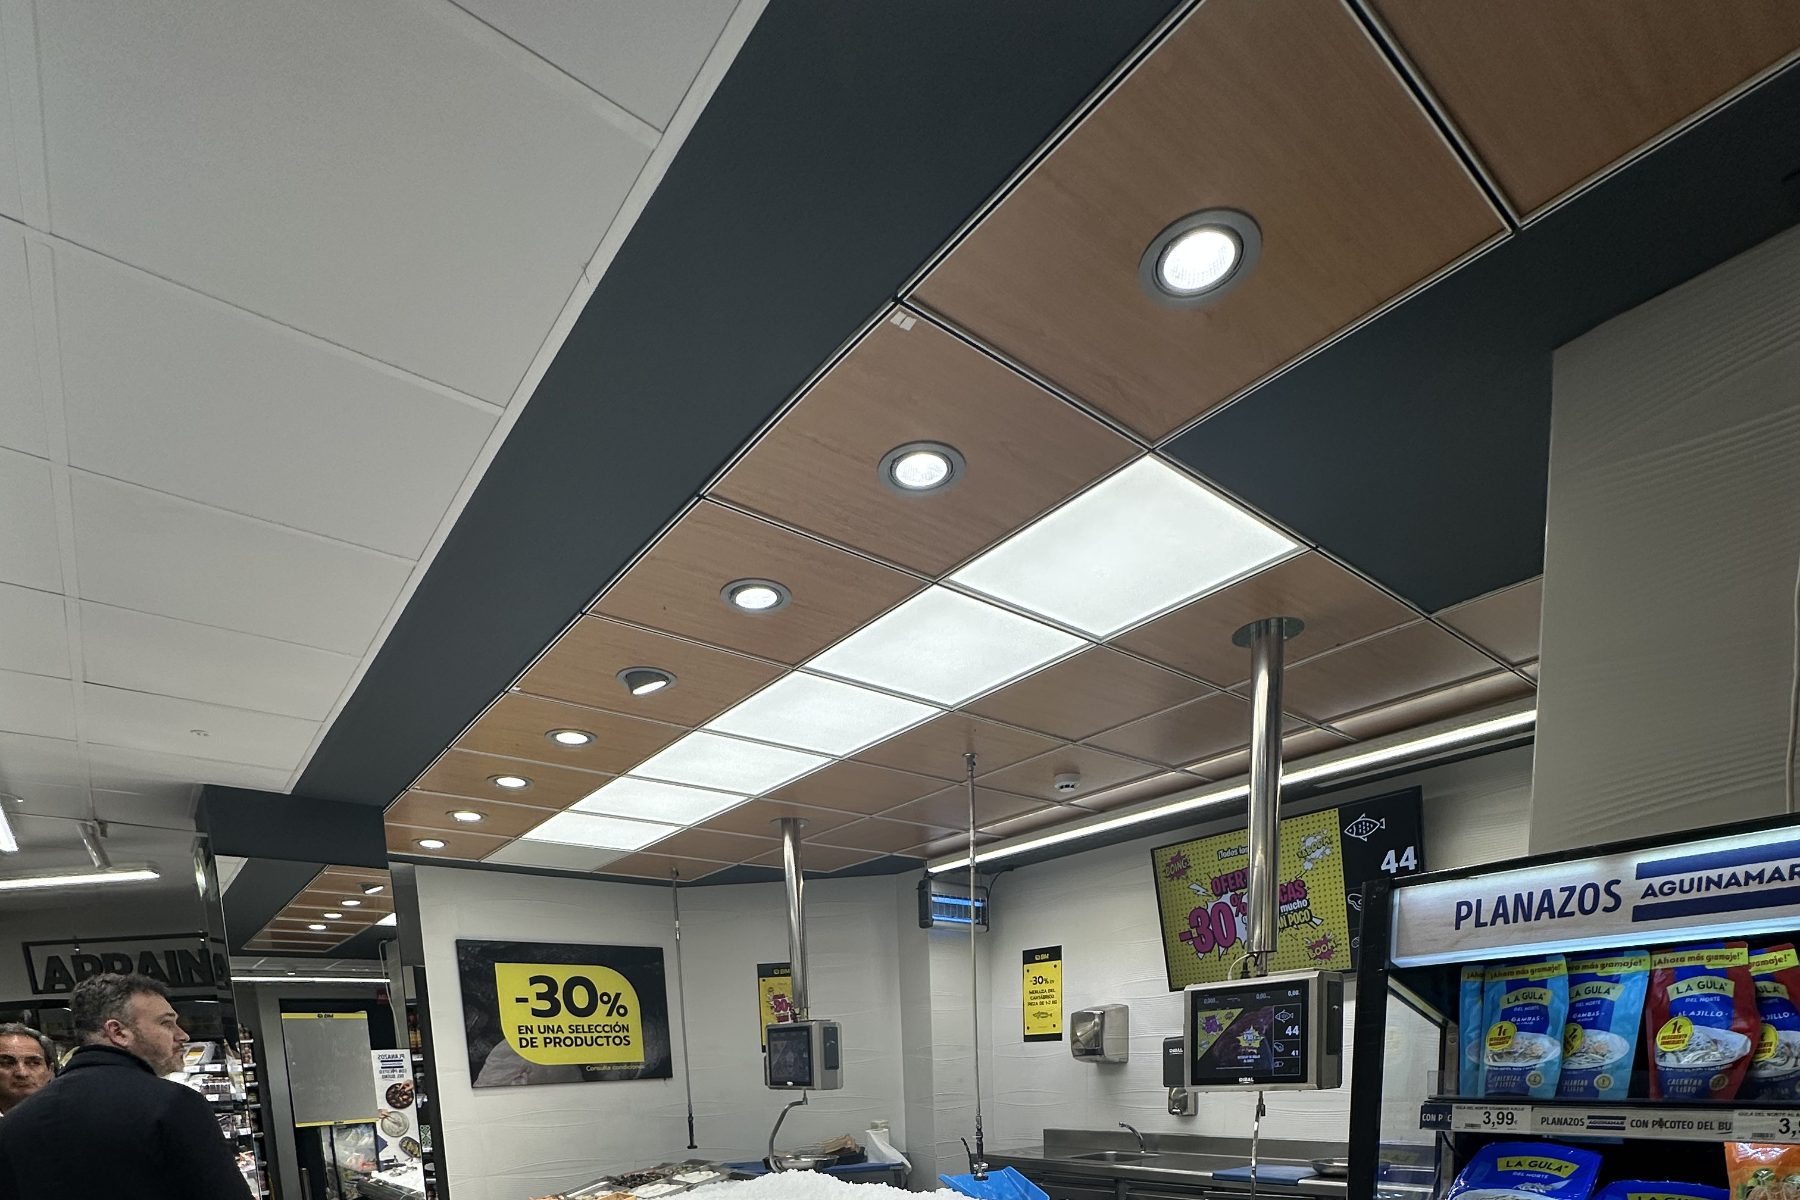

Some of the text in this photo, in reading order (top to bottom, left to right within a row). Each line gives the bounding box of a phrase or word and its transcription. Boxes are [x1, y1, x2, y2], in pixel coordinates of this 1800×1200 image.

[1380, 845, 1418, 874] 44
[1279, 879, 1308, 903] CAS
[1454, 879, 1622, 930] PLANAZOS
[1288, 909, 1311, 926] POCO
[1581, 961, 1599, 971] más
[1653, 955, 1685, 967] ¡Ahora
[1687, 953, 1704, 962] más
[1584, 985, 1612, 996] GULA
[1676, 980, 1726, 995] LA GULA
[515, 974, 629, 1019] -30%
[1506, 991, 1545, 1005] LA GULA
[517, 1021, 630, 1035] EN UNA SELECCIÓN
[1285, 1025, 1299, 1036] 44
[518, 1035, 631, 1049] DE PRODUCTOS
[1422, 1112, 1437, 1122] CON
[1540, 1116, 1585, 1127] PLANAZOS
[1630, 1119, 1649, 1129] CON
[1697, 1121, 1715, 1131] DEL
[1505, 1160, 1565, 1173] LA GULA
